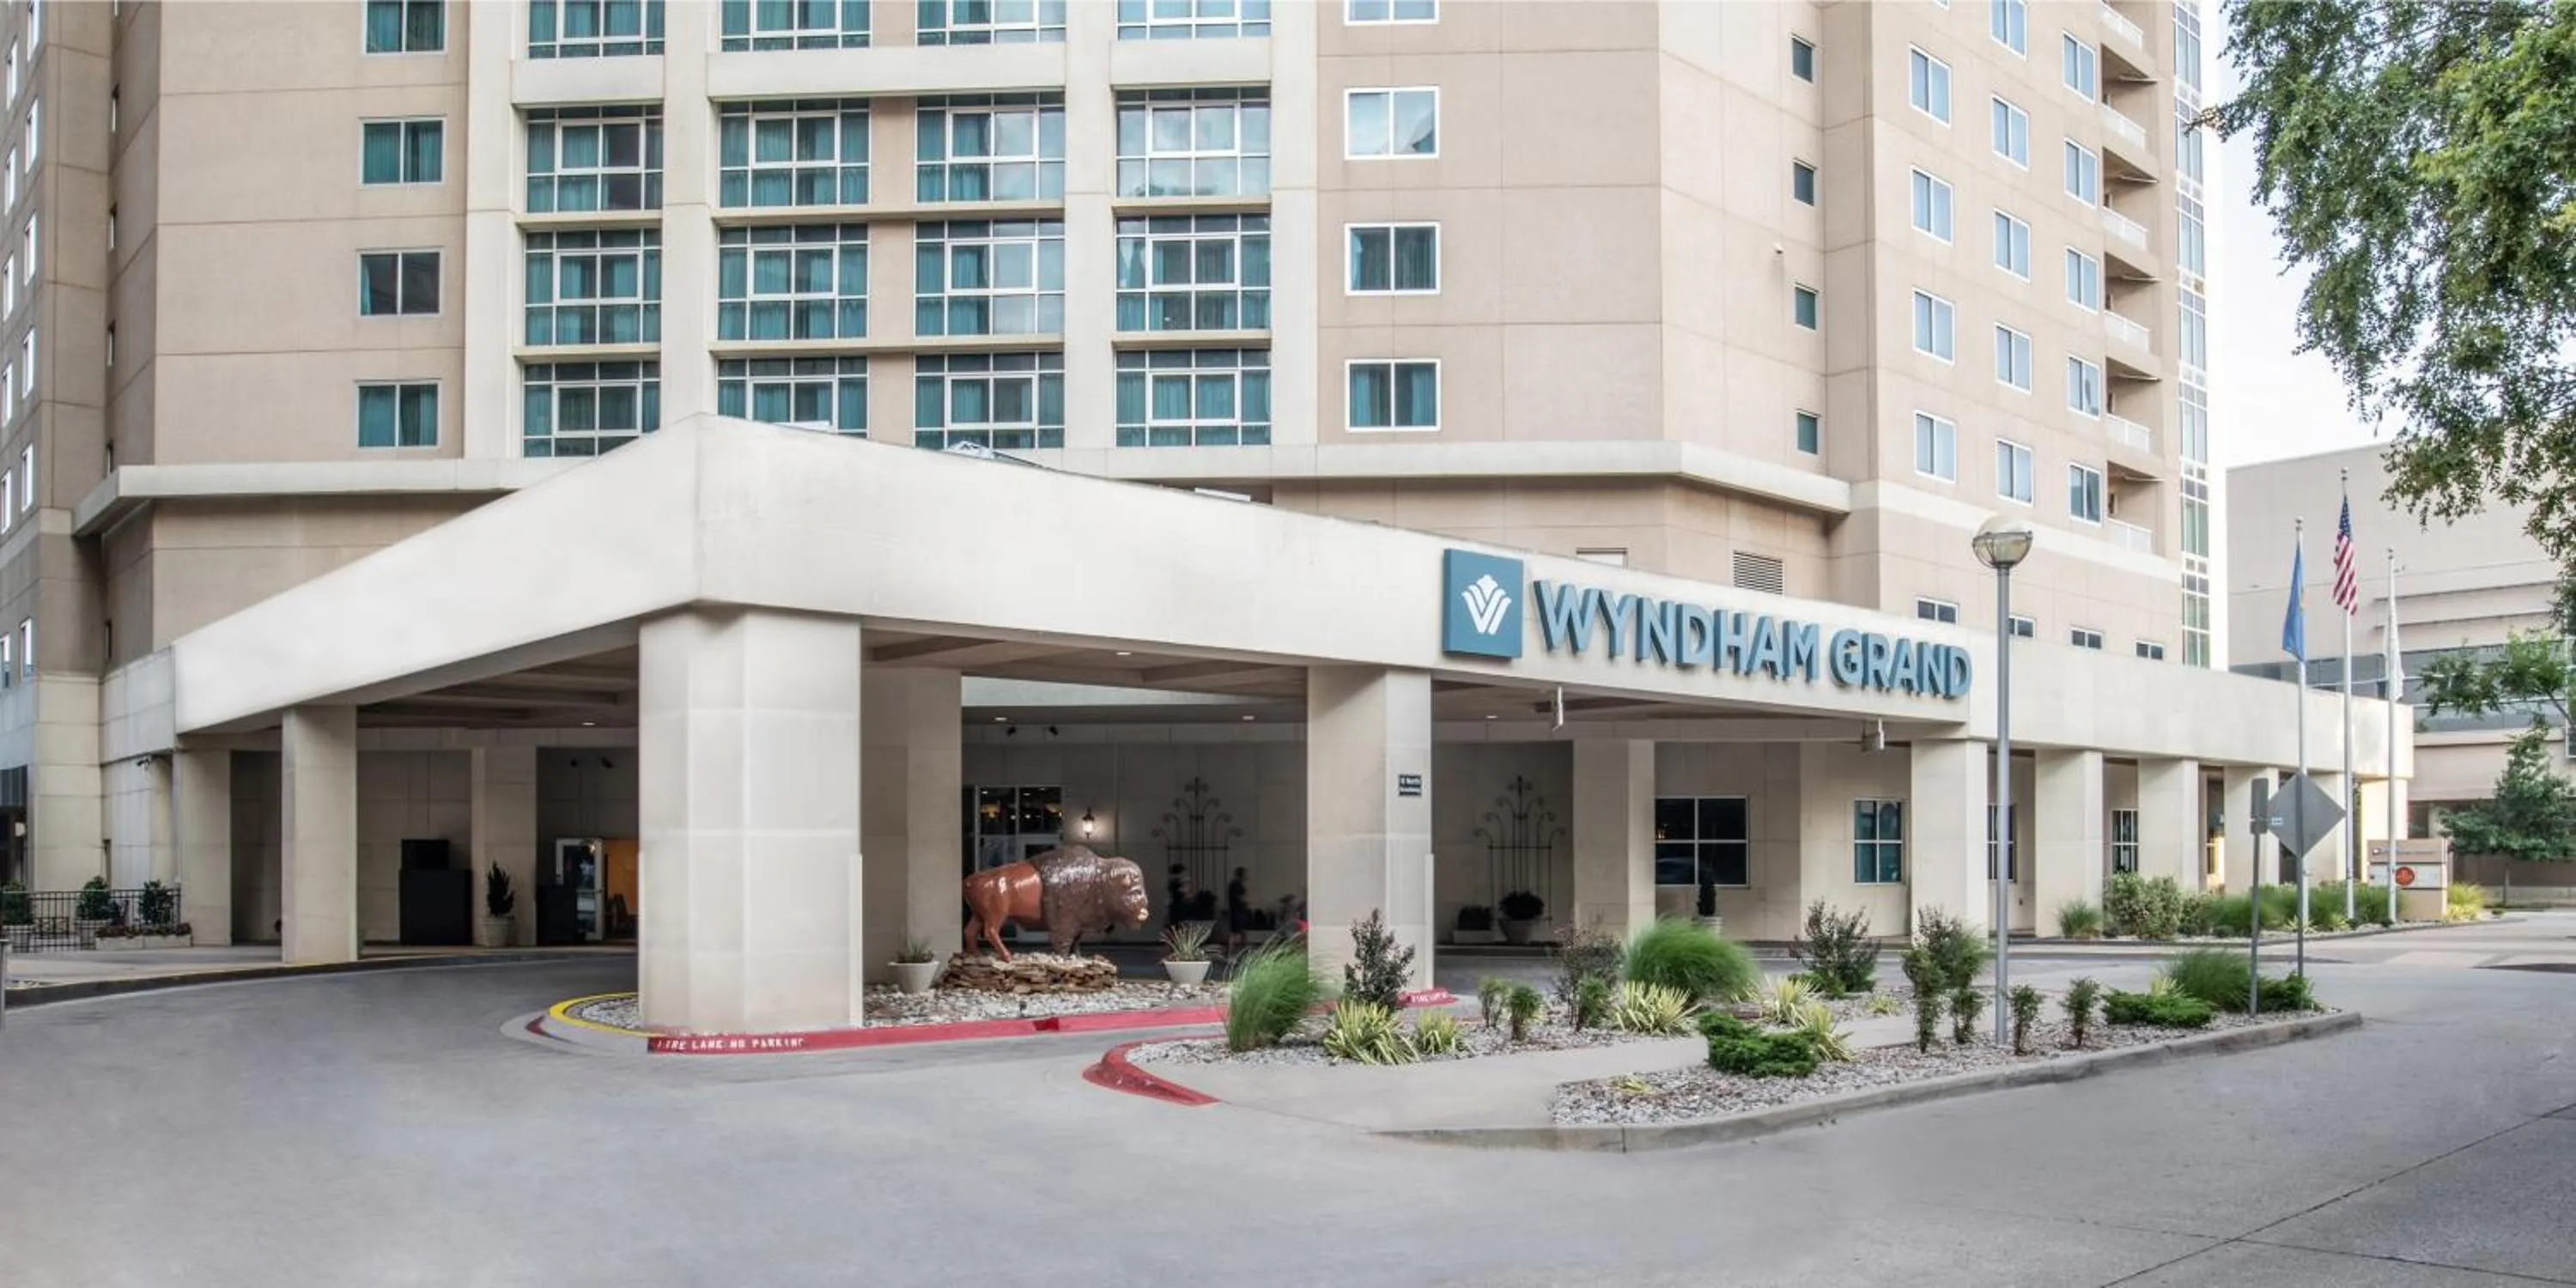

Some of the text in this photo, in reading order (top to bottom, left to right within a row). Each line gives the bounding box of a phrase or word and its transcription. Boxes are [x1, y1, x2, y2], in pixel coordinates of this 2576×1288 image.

[1534, 580, 1972, 698] WYNDHAM GRAND
[691, 1038, 723, 1049] LANE
